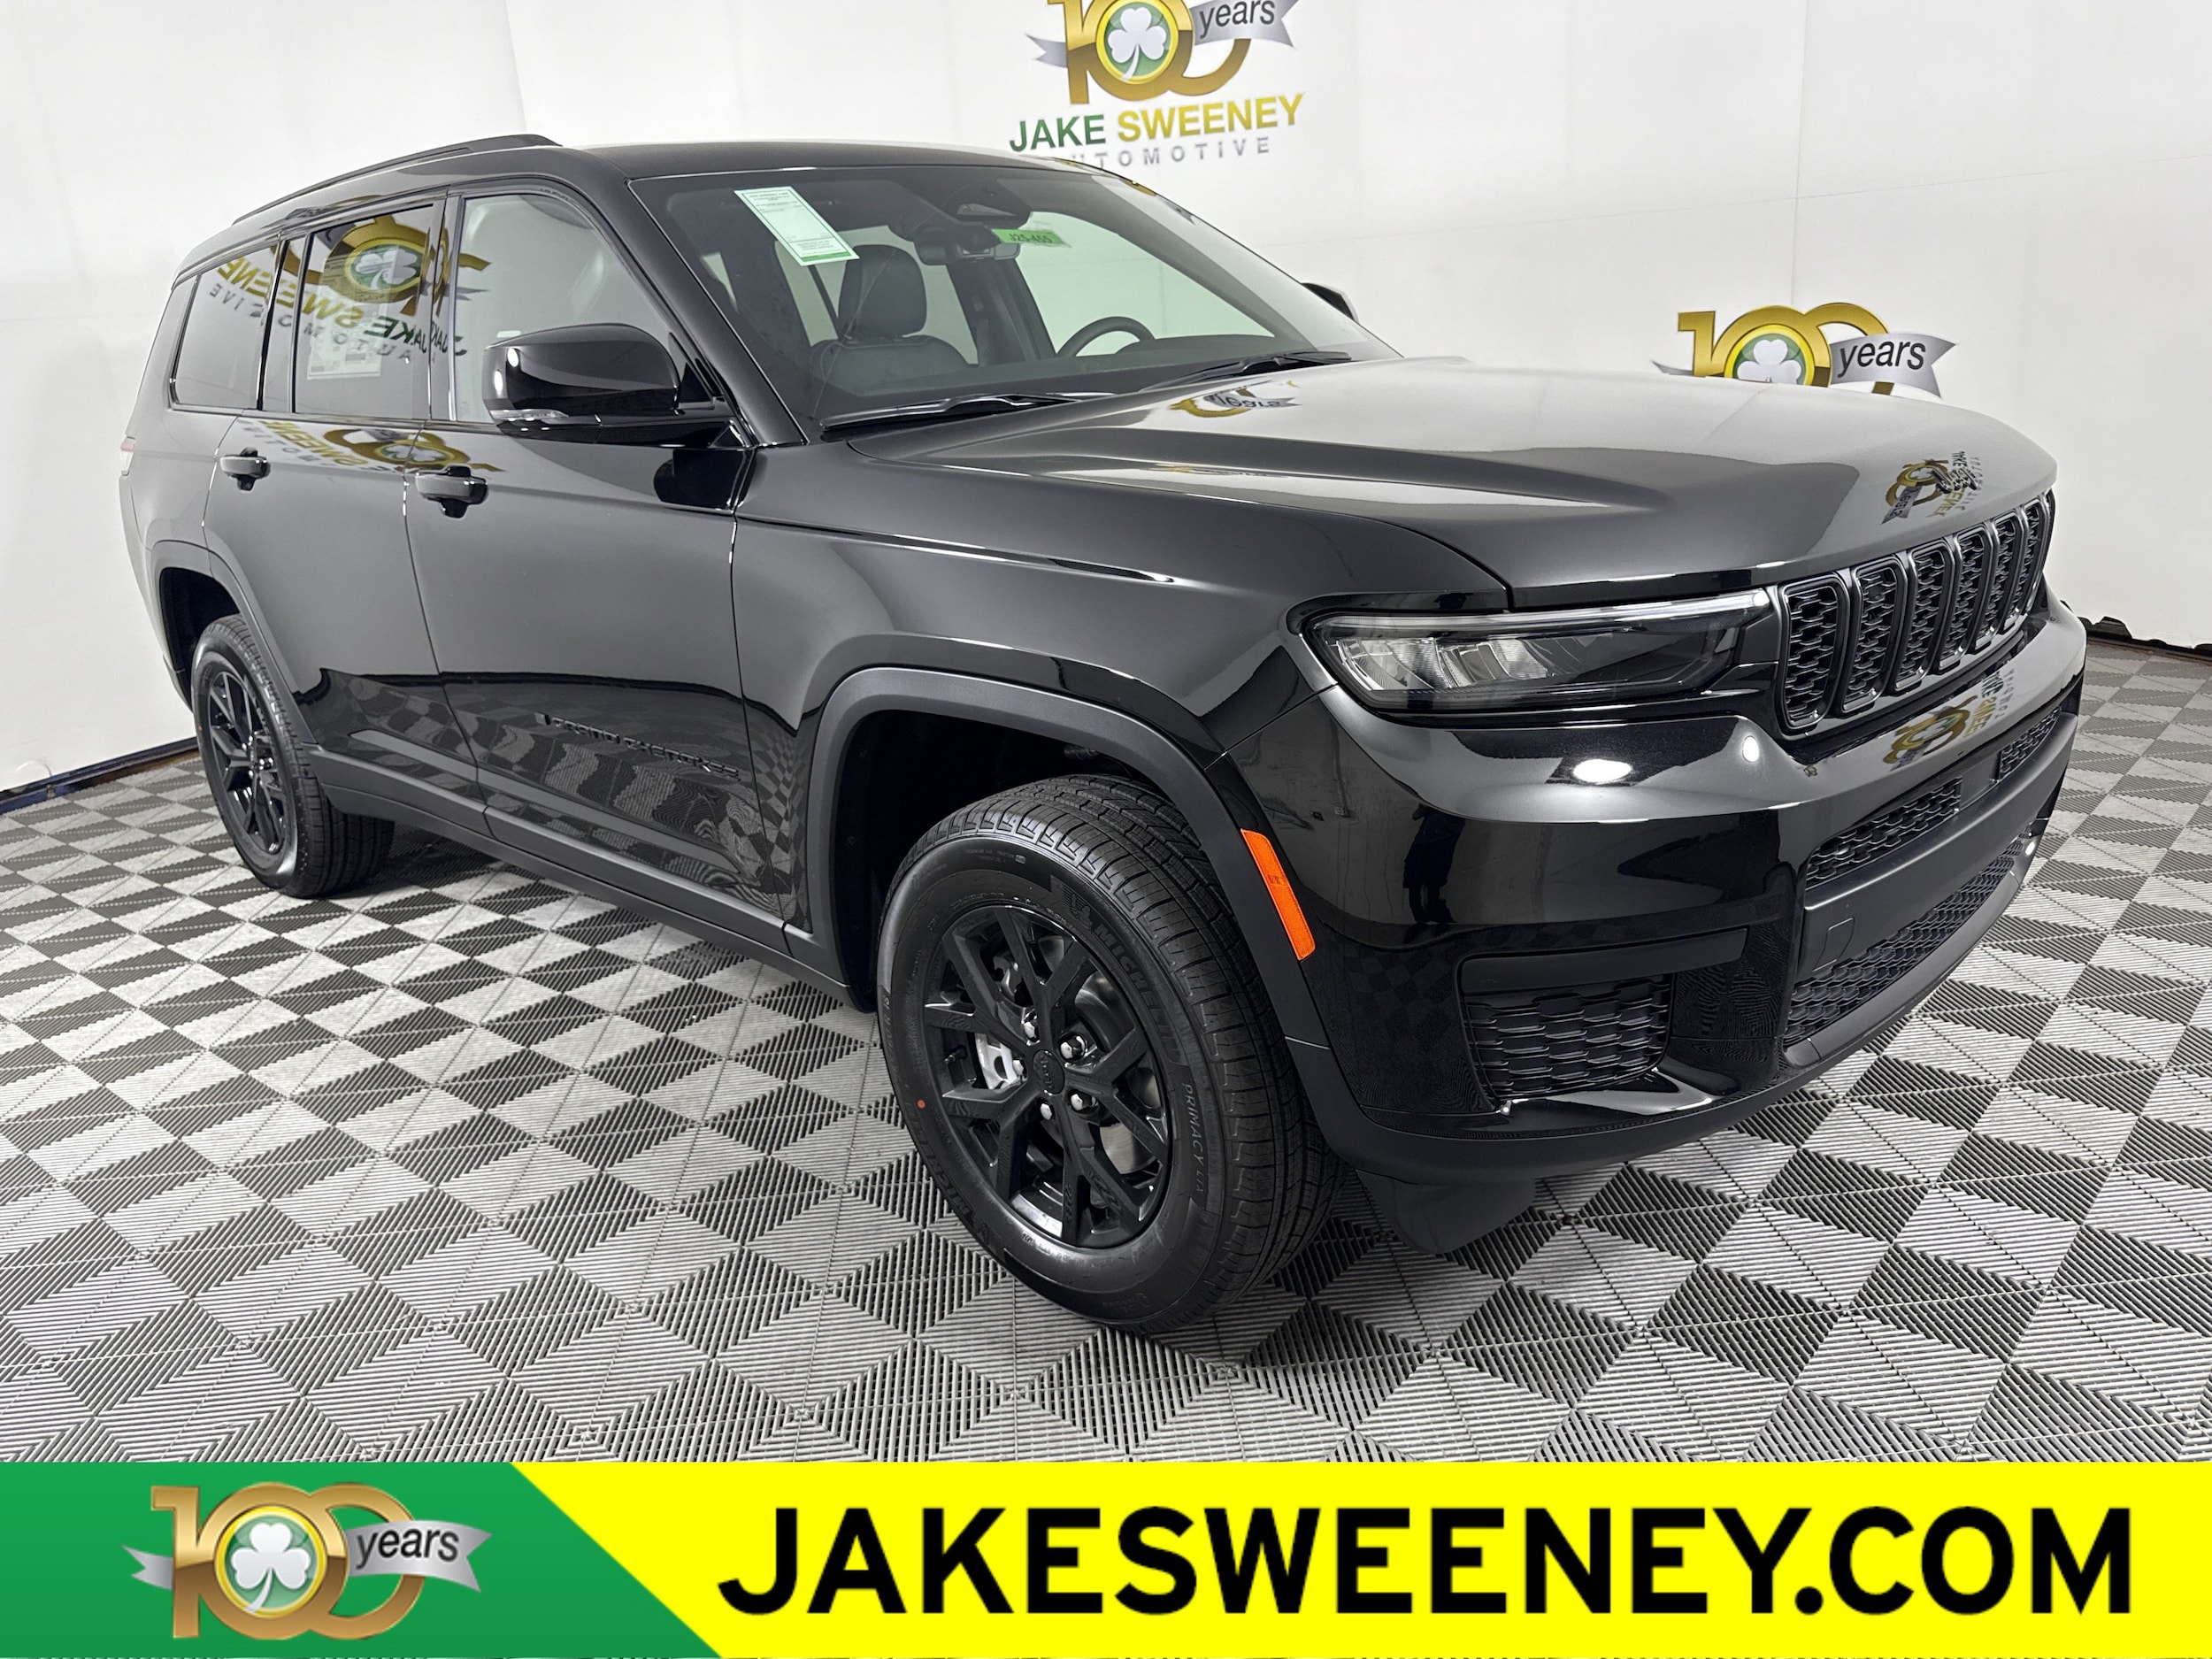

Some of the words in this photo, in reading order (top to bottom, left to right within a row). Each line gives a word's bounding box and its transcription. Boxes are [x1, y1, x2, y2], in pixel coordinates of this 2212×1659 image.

[1199, 0, 1276, 40] years
[1009, 113, 1107, 153] JAKE
[1117, 93, 1305, 143] SWEENEY
[1071, 136, 1271, 168] TOMOTIVE
[1837, 337, 1926, 378] years
[1095, 923, 1184, 1058] MICHELIN
[1182, 1082, 1205, 1166] PRIMACY
